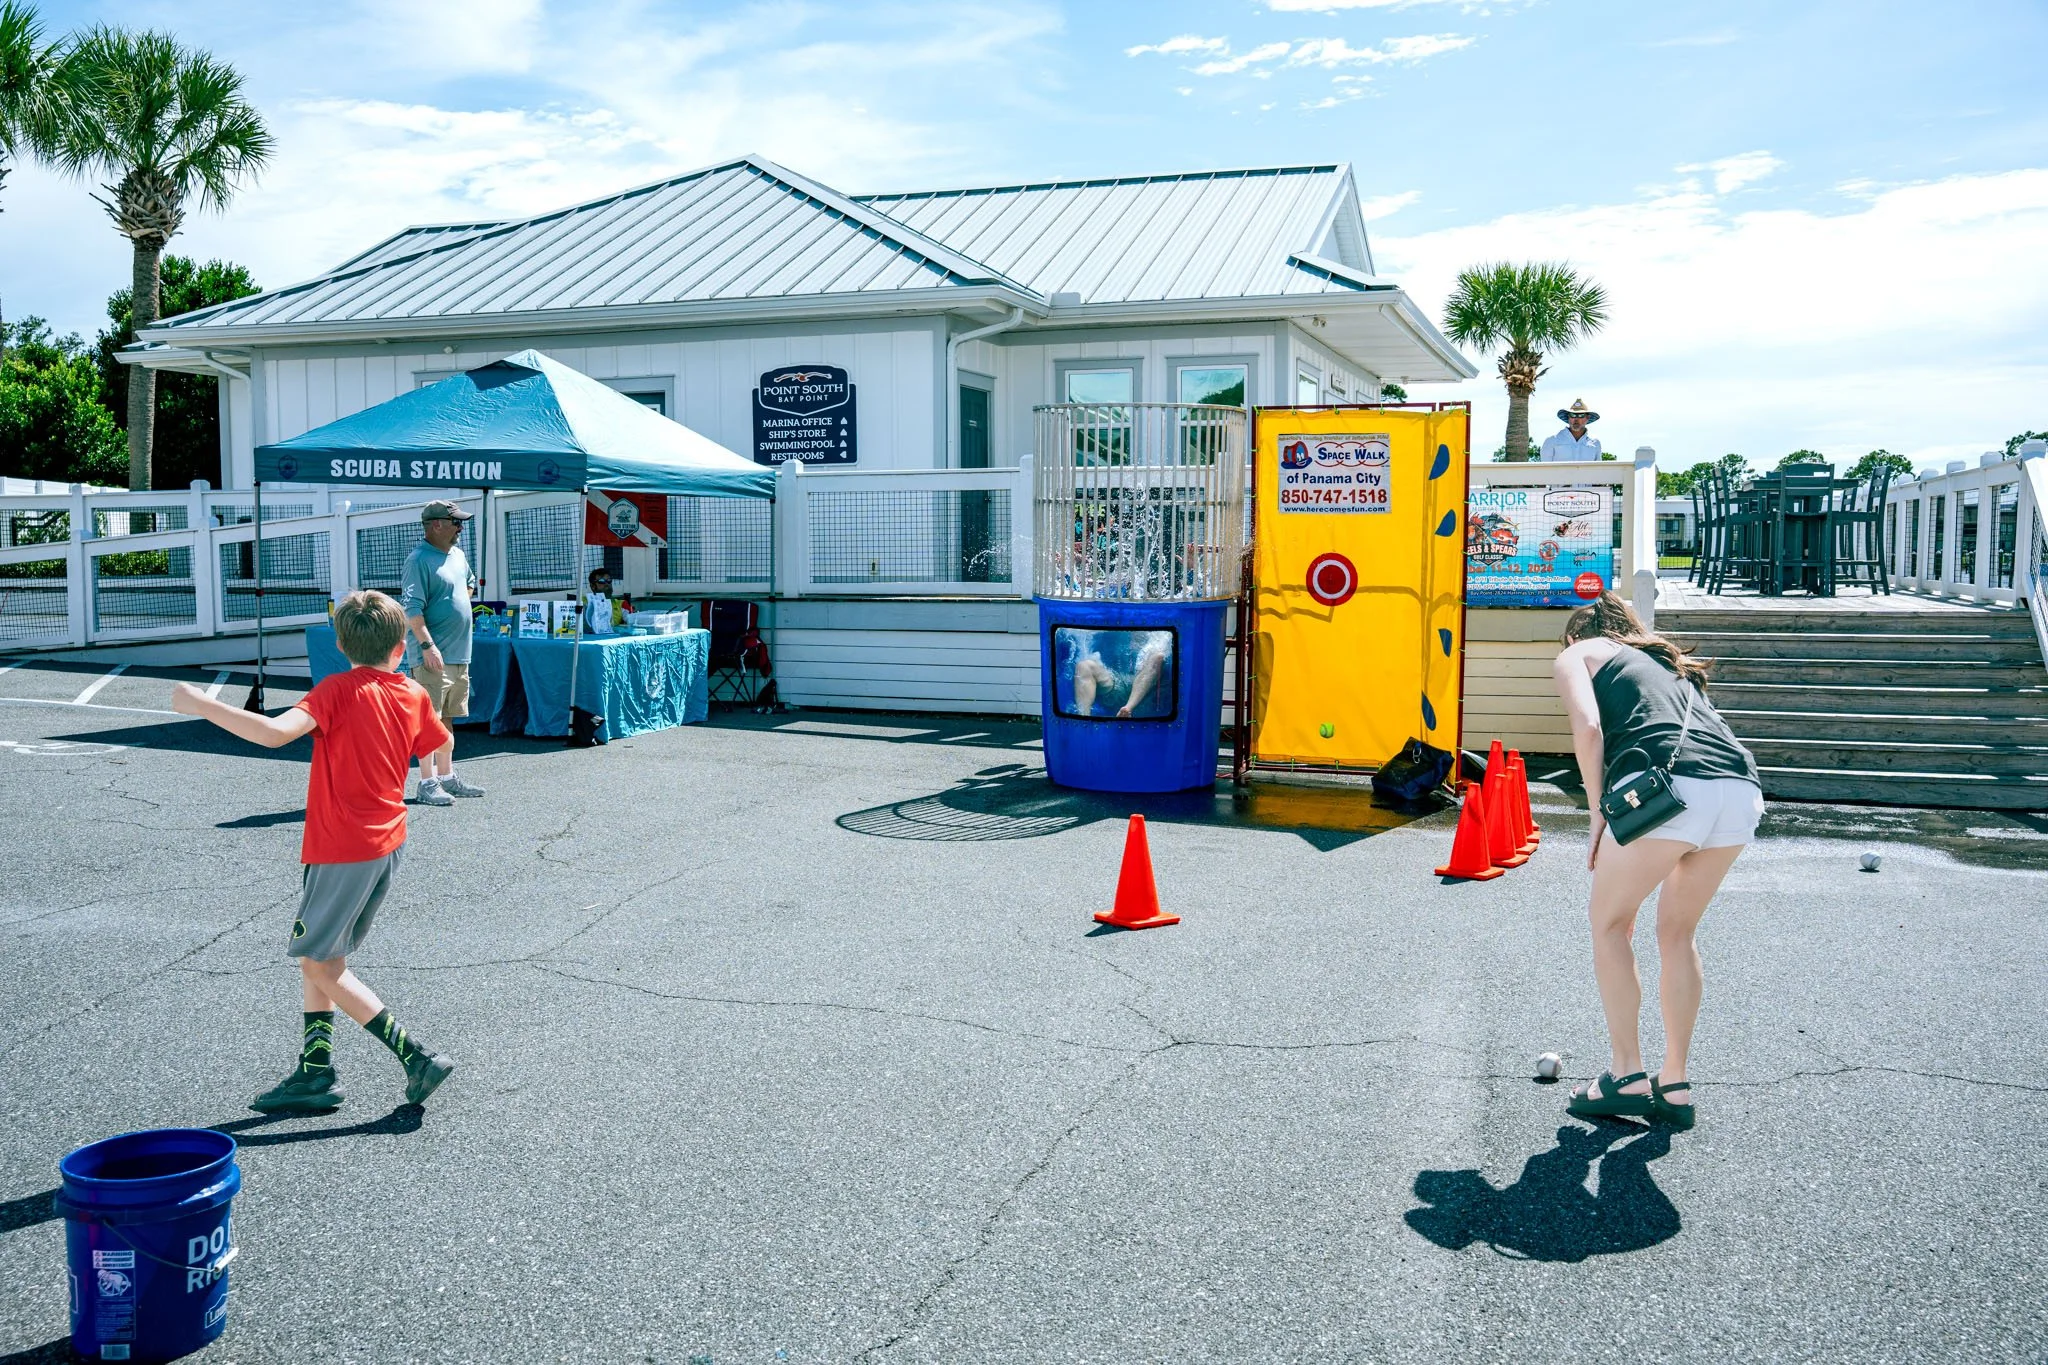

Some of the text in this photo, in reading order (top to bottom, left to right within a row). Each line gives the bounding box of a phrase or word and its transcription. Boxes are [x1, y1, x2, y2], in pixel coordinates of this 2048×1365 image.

[764, 384, 844, 396] POINT SOUTH
[763, 418, 833, 428] MARINA OFFICE
[769, 429, 827, 439] SHIP'S STORE
[760, 440, 835, 450] SWIMMING POOL
[771, 452, 825, 461] RESTROOMS
[331, 459, 502, 480] SCUBA STATION
[1287, 473, 1381, 486] of Panama City
[1282, 489, 1387, 504] 850-747-1518
[1468, 492, 1527, 509] ARRIOR
[1484, 545, 1489, 553] &
[1491, 545, 1517, 556] SPEARS
[528, 604, 541, 612] TRY
[188, 1226, 224, 1265] DO
